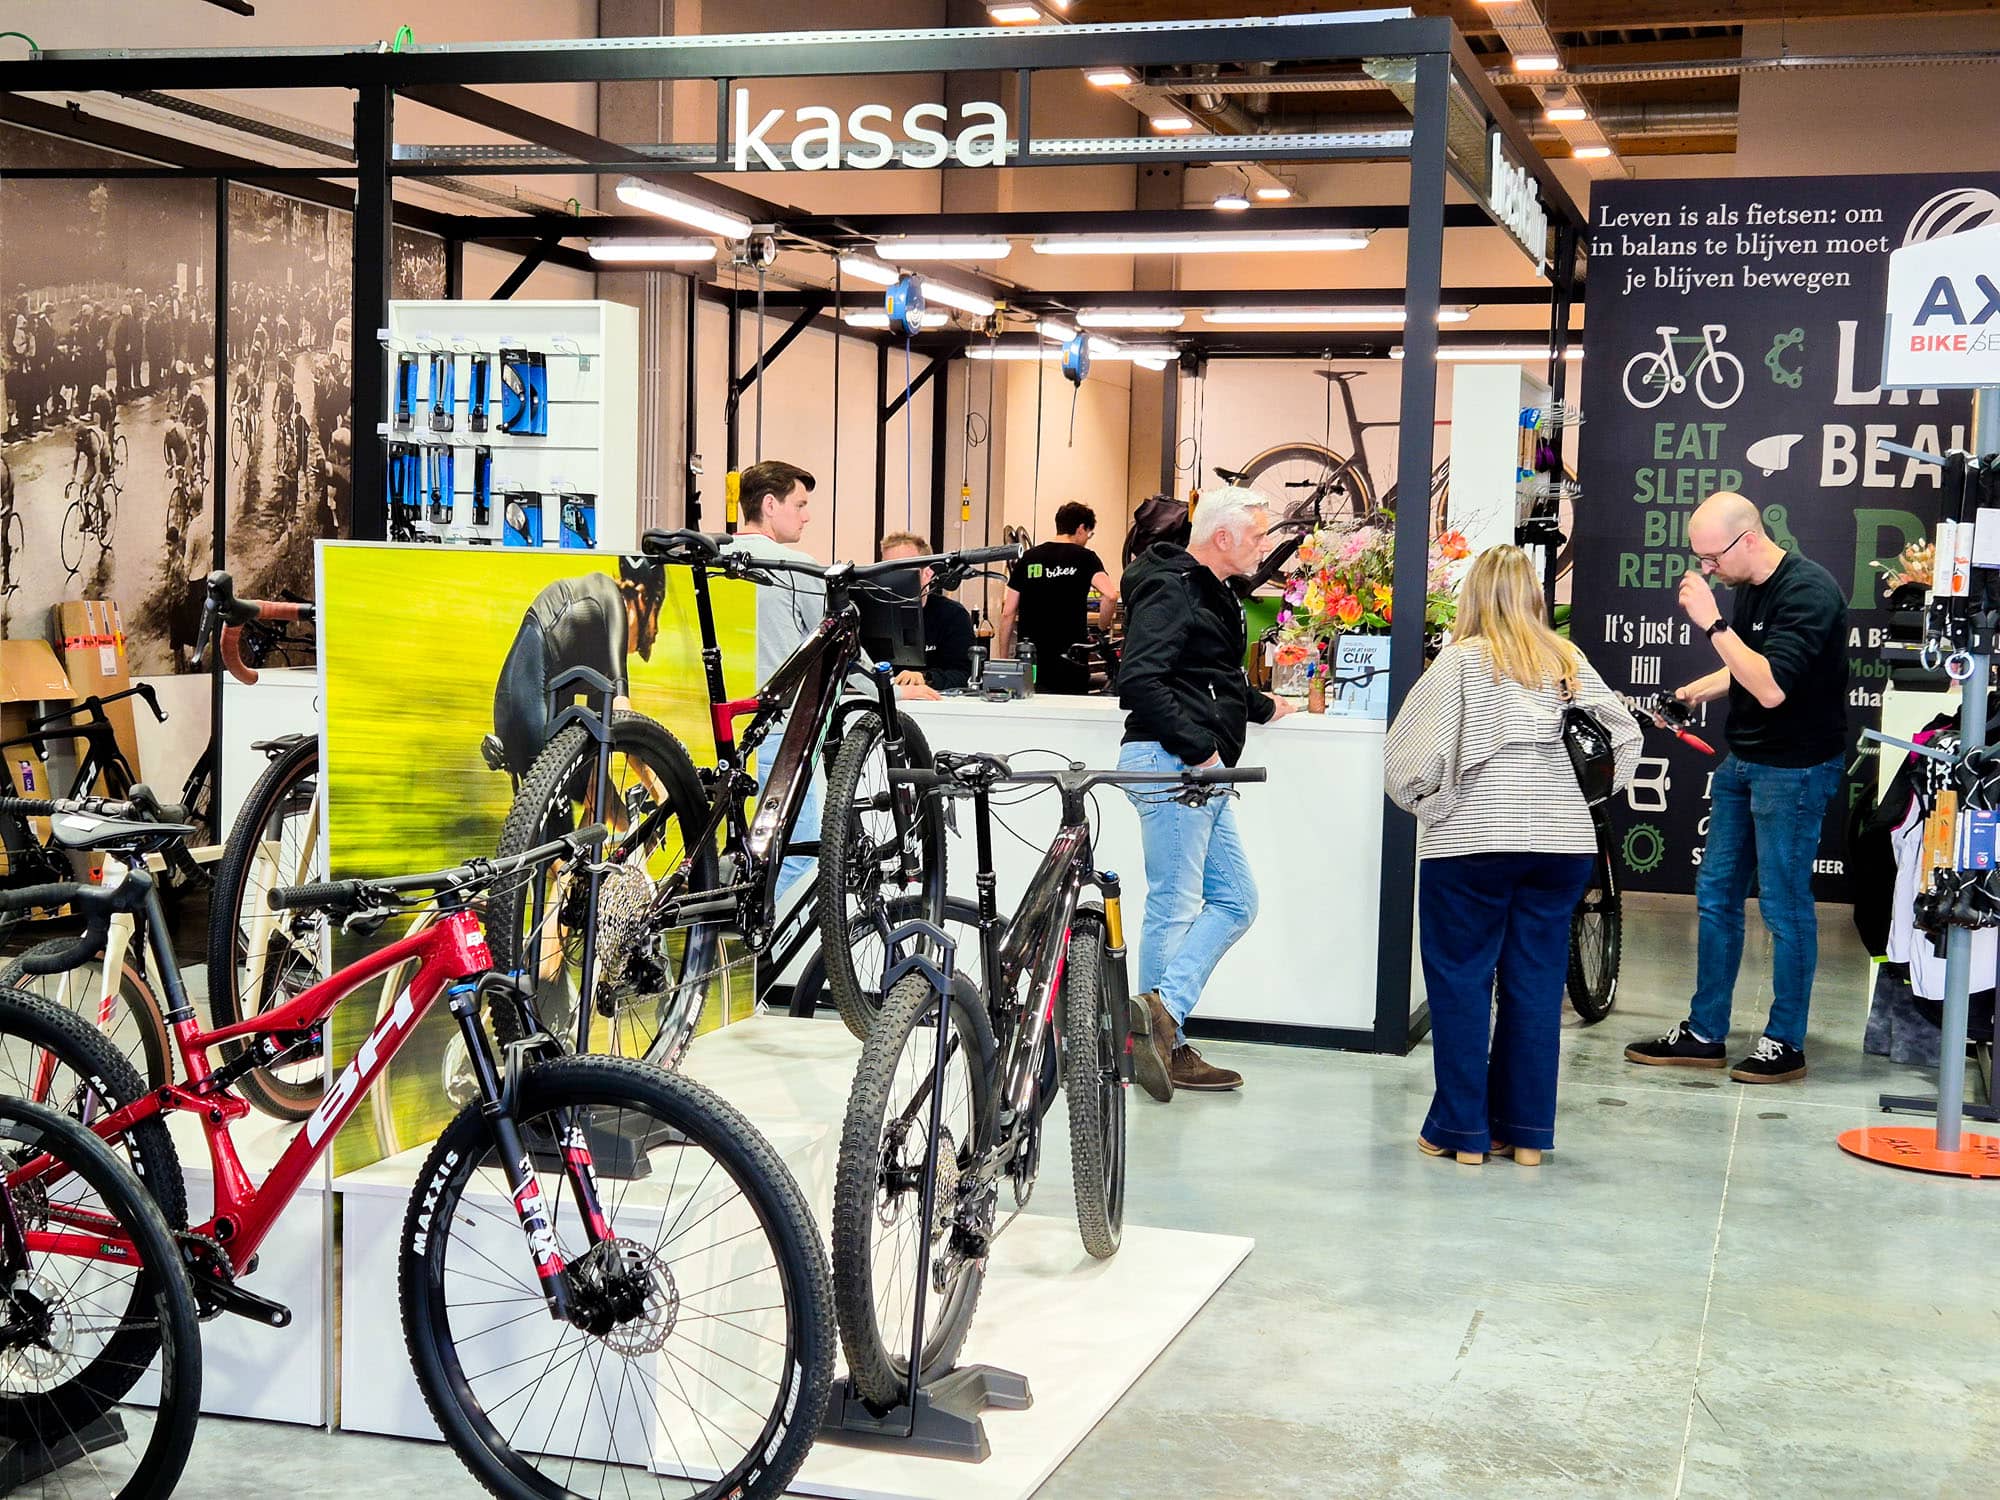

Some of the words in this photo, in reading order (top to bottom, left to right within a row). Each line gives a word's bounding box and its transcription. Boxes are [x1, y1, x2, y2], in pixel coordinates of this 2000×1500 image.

[734, 88, 1008, 172] kassa
[1599, 205, 1672, 228] Leven
[1679, 205, 1699, 226] is
[1706, 204, 1739, 226] als
[1746, 202, 1837, 226] fietsen:
[1845, 208, 1883, 224] om
[1590, 235, 1614, 257] in
[1621, 234, 1698, 257] balans
[1704, 237, 1728, 256] te
[1736, 233, 1818, 261] blijven
[1826, 235, 1890, 254] moet
[1622, 267, 1647, 295] je
[1654, 266, 1735, 295] blijven
[1743, 265, 1851, 294] bewegen
[1653, 422, 1728, 461] EAT
[1632, 467, 1743, 505] SLEEP
[1643, 510, 1692, 548] BI
[1045, 565, 1078, 579] bikes
[1604, 613, 1634, 643] It's
[1637, 615, 1675, 649] just
[1679, 623, 1691, 646] a
[1848, 627, 1861, 648] A
[1343, 652, 1373, 665] CLIK
[1630, 655, 1662, 685] Hill
[1848, 658, 1893, 679] Mobi
[1849, 686, 1882, 707] tha
[306, 984, 415, 1149] BH
[90, 1075, 145, 1177] MAXIS
[413, 1150, 460, 1257] MAXXIS
